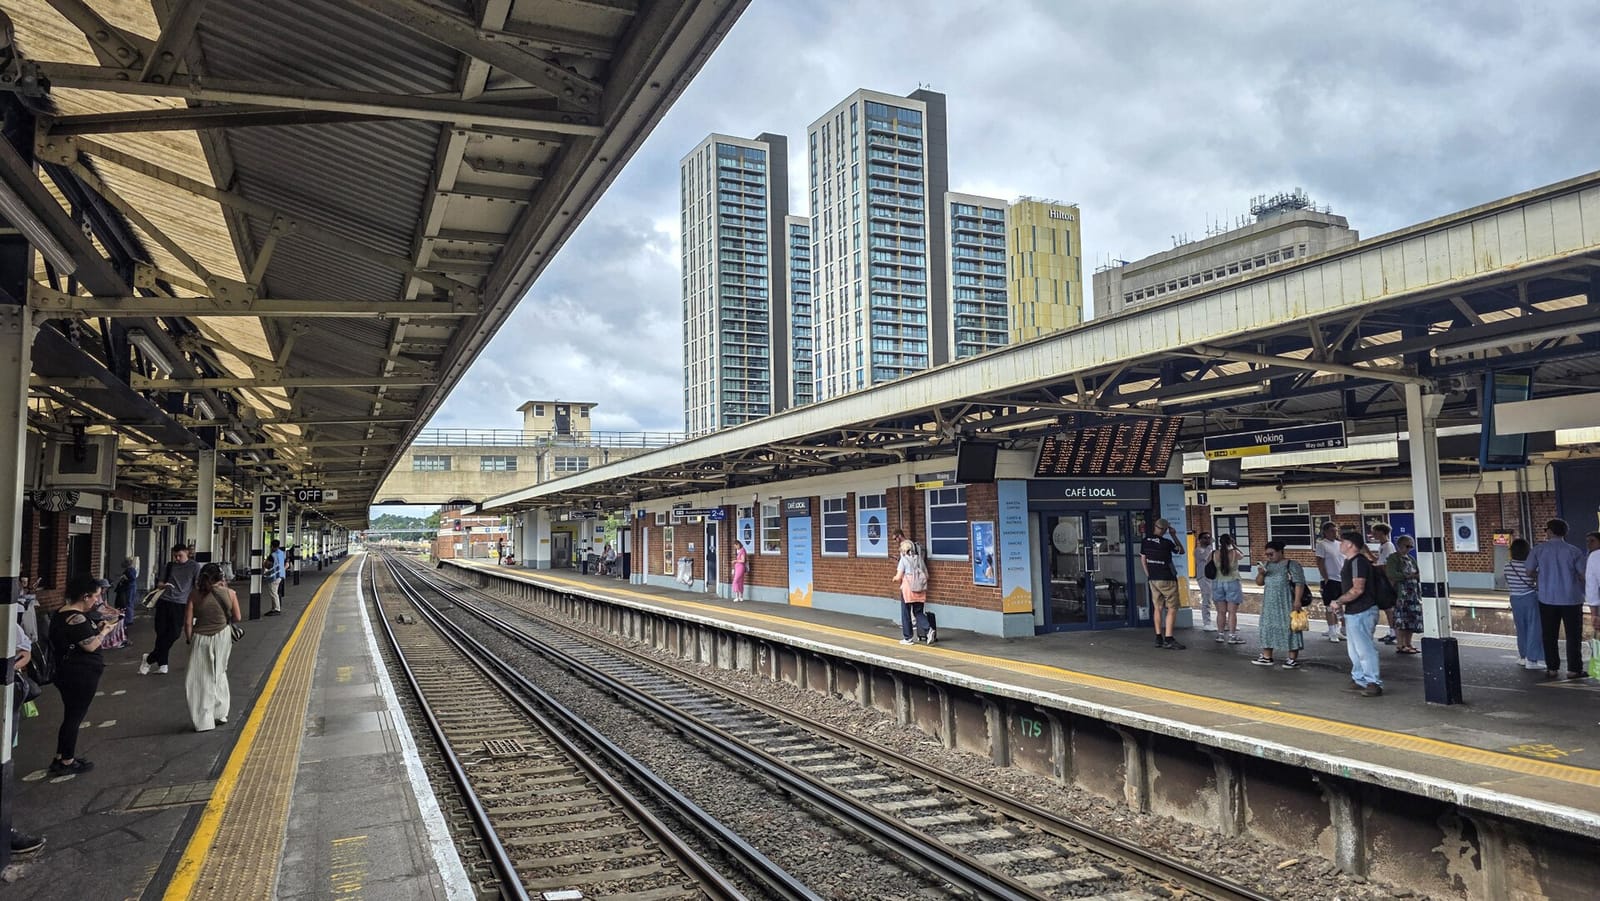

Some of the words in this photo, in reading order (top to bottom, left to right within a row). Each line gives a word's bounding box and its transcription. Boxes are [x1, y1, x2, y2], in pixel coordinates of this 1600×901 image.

[1049, 209, 1075, 221] Hilton
[1254, 433, 1284, 443] Woking
[298, 490, 321, 501] OFF
[1064, 485, 1087, 497] CAFÉ
[1089, 488, 1116, 497] LOCAL
[265, 496, 276, 511] 5
